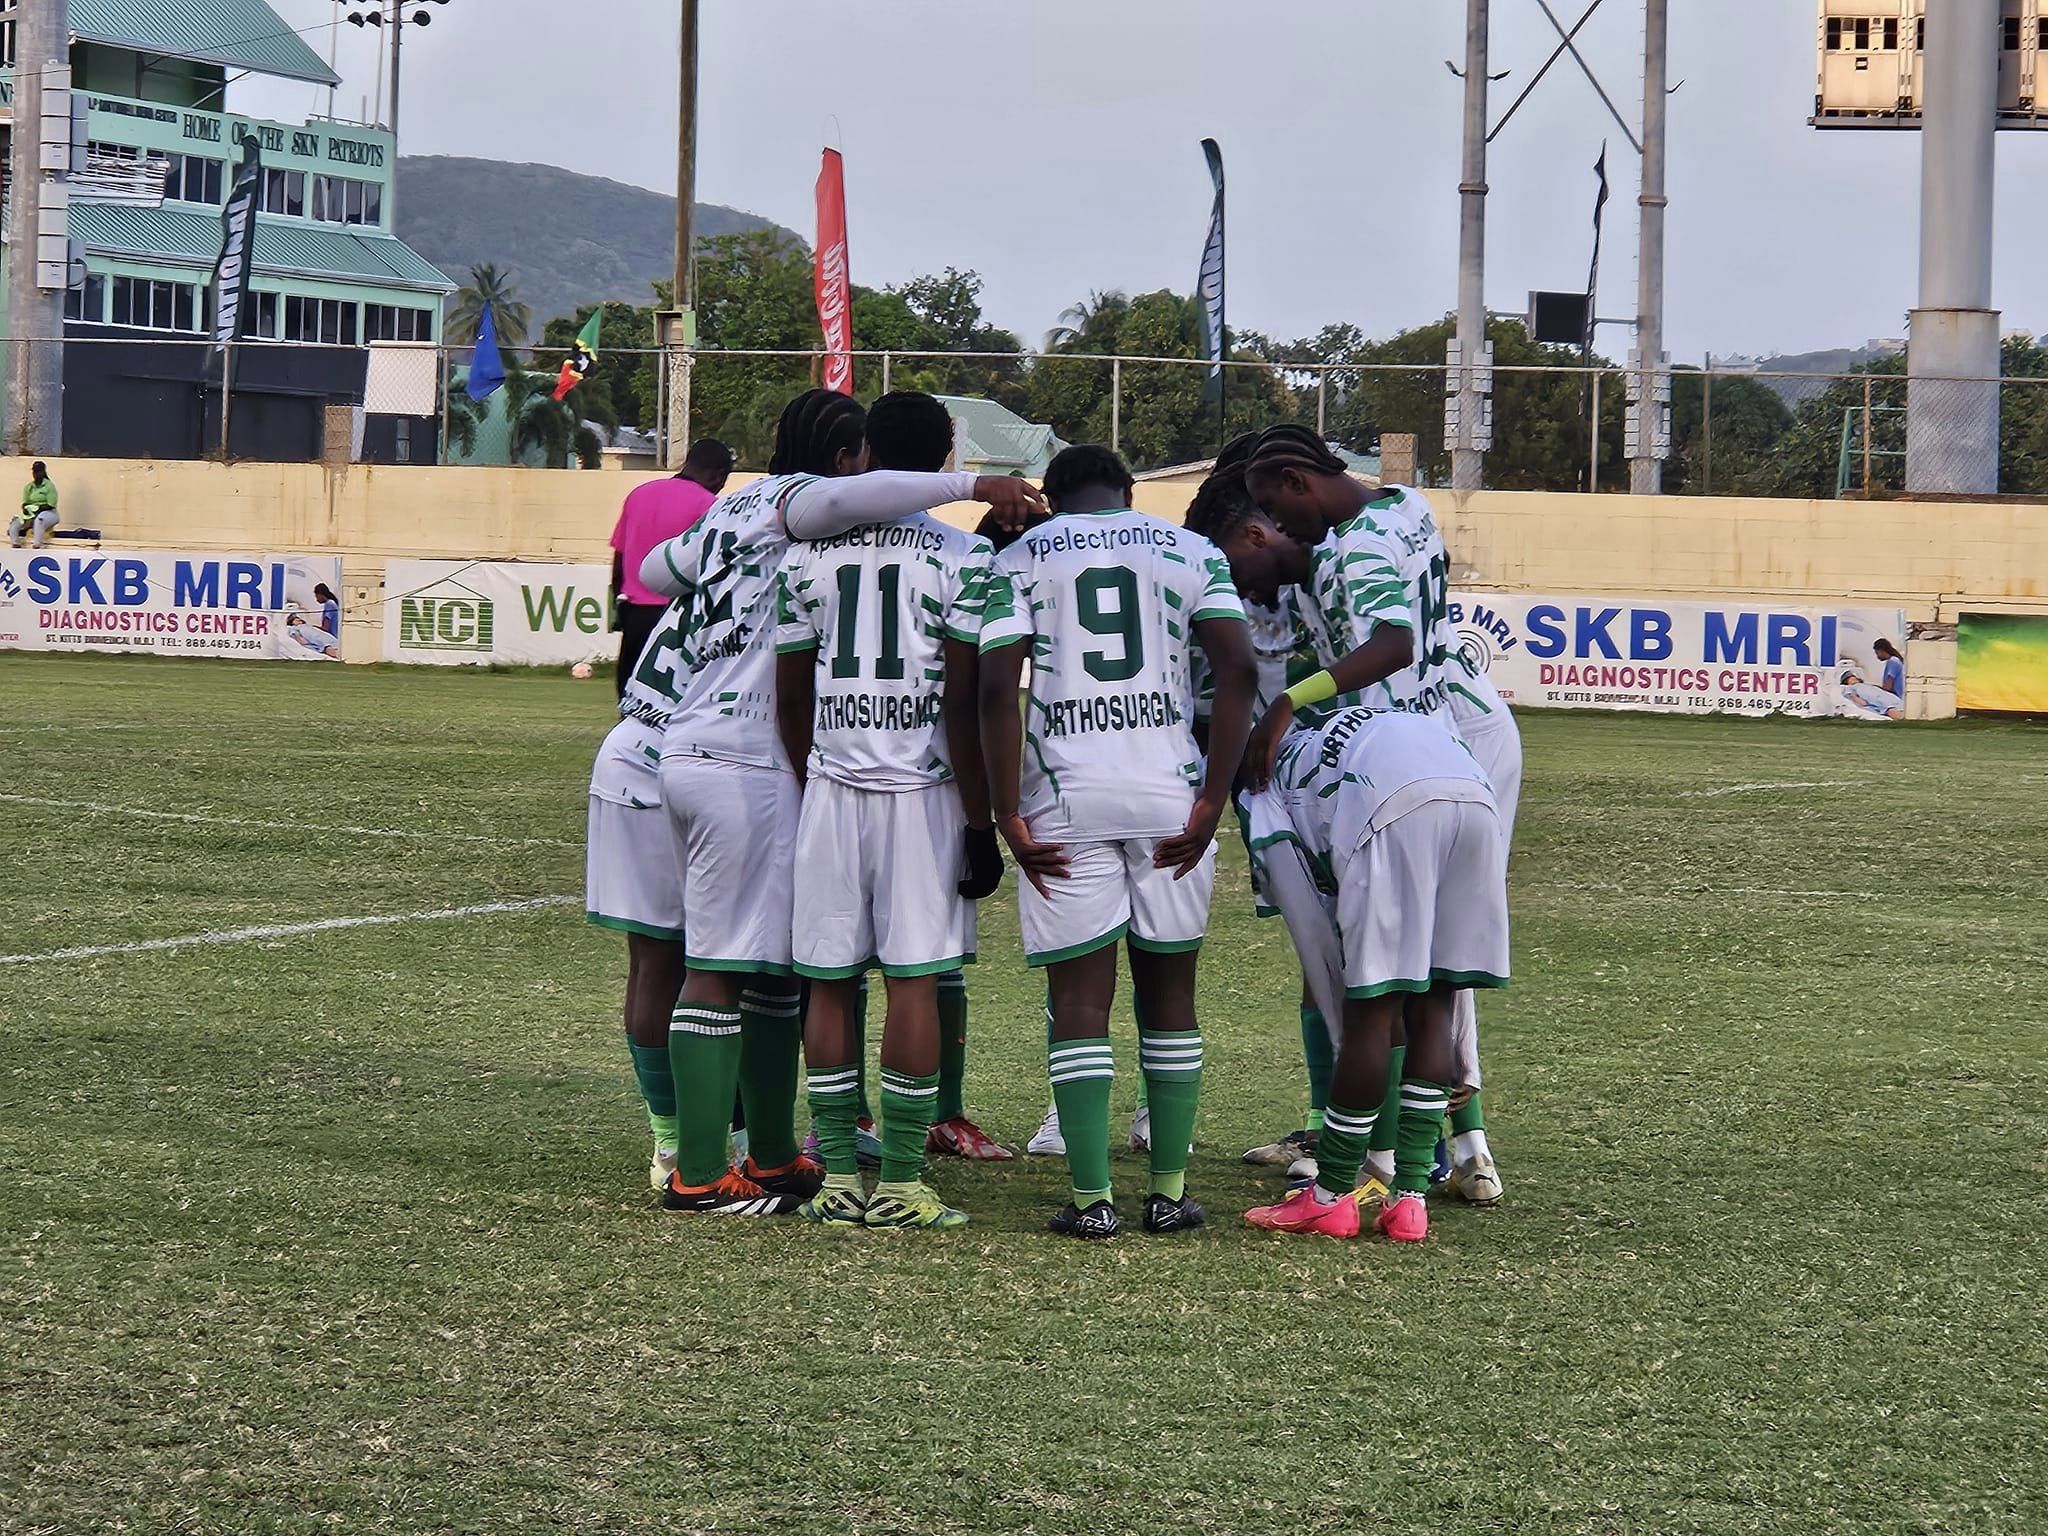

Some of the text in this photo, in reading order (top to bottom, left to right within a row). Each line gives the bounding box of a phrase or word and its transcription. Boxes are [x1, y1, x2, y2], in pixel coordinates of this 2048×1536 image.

[183, 113, 220, 142] HOME
[257, 126, 284, 151] THE
[292, 132, 320, 157] SKN
[328, 137, 384, 167] PATRIOTS
[27, 556, 286, 611] SKB MRI
[39, 609, 269, 635] DIAGNOSTICS CENTER
[400, 599, 494, 645] NCI
[521, 584, 616, 634] Wel
[831, 564, 905, 680] 11
[1075, 565, 1145, 682] 9
[1471, 605, 1517, 651] MRI
[161, 637, 182, 647] TEL:
[1524, 605, 1838, 667] SKB MRI
[1540, 663, 1819, 695] DIAGNOSTICS CENTER
[1564, 692, 1591, 702] KITTS
[1687, 696, 1713, 707] TEL:
